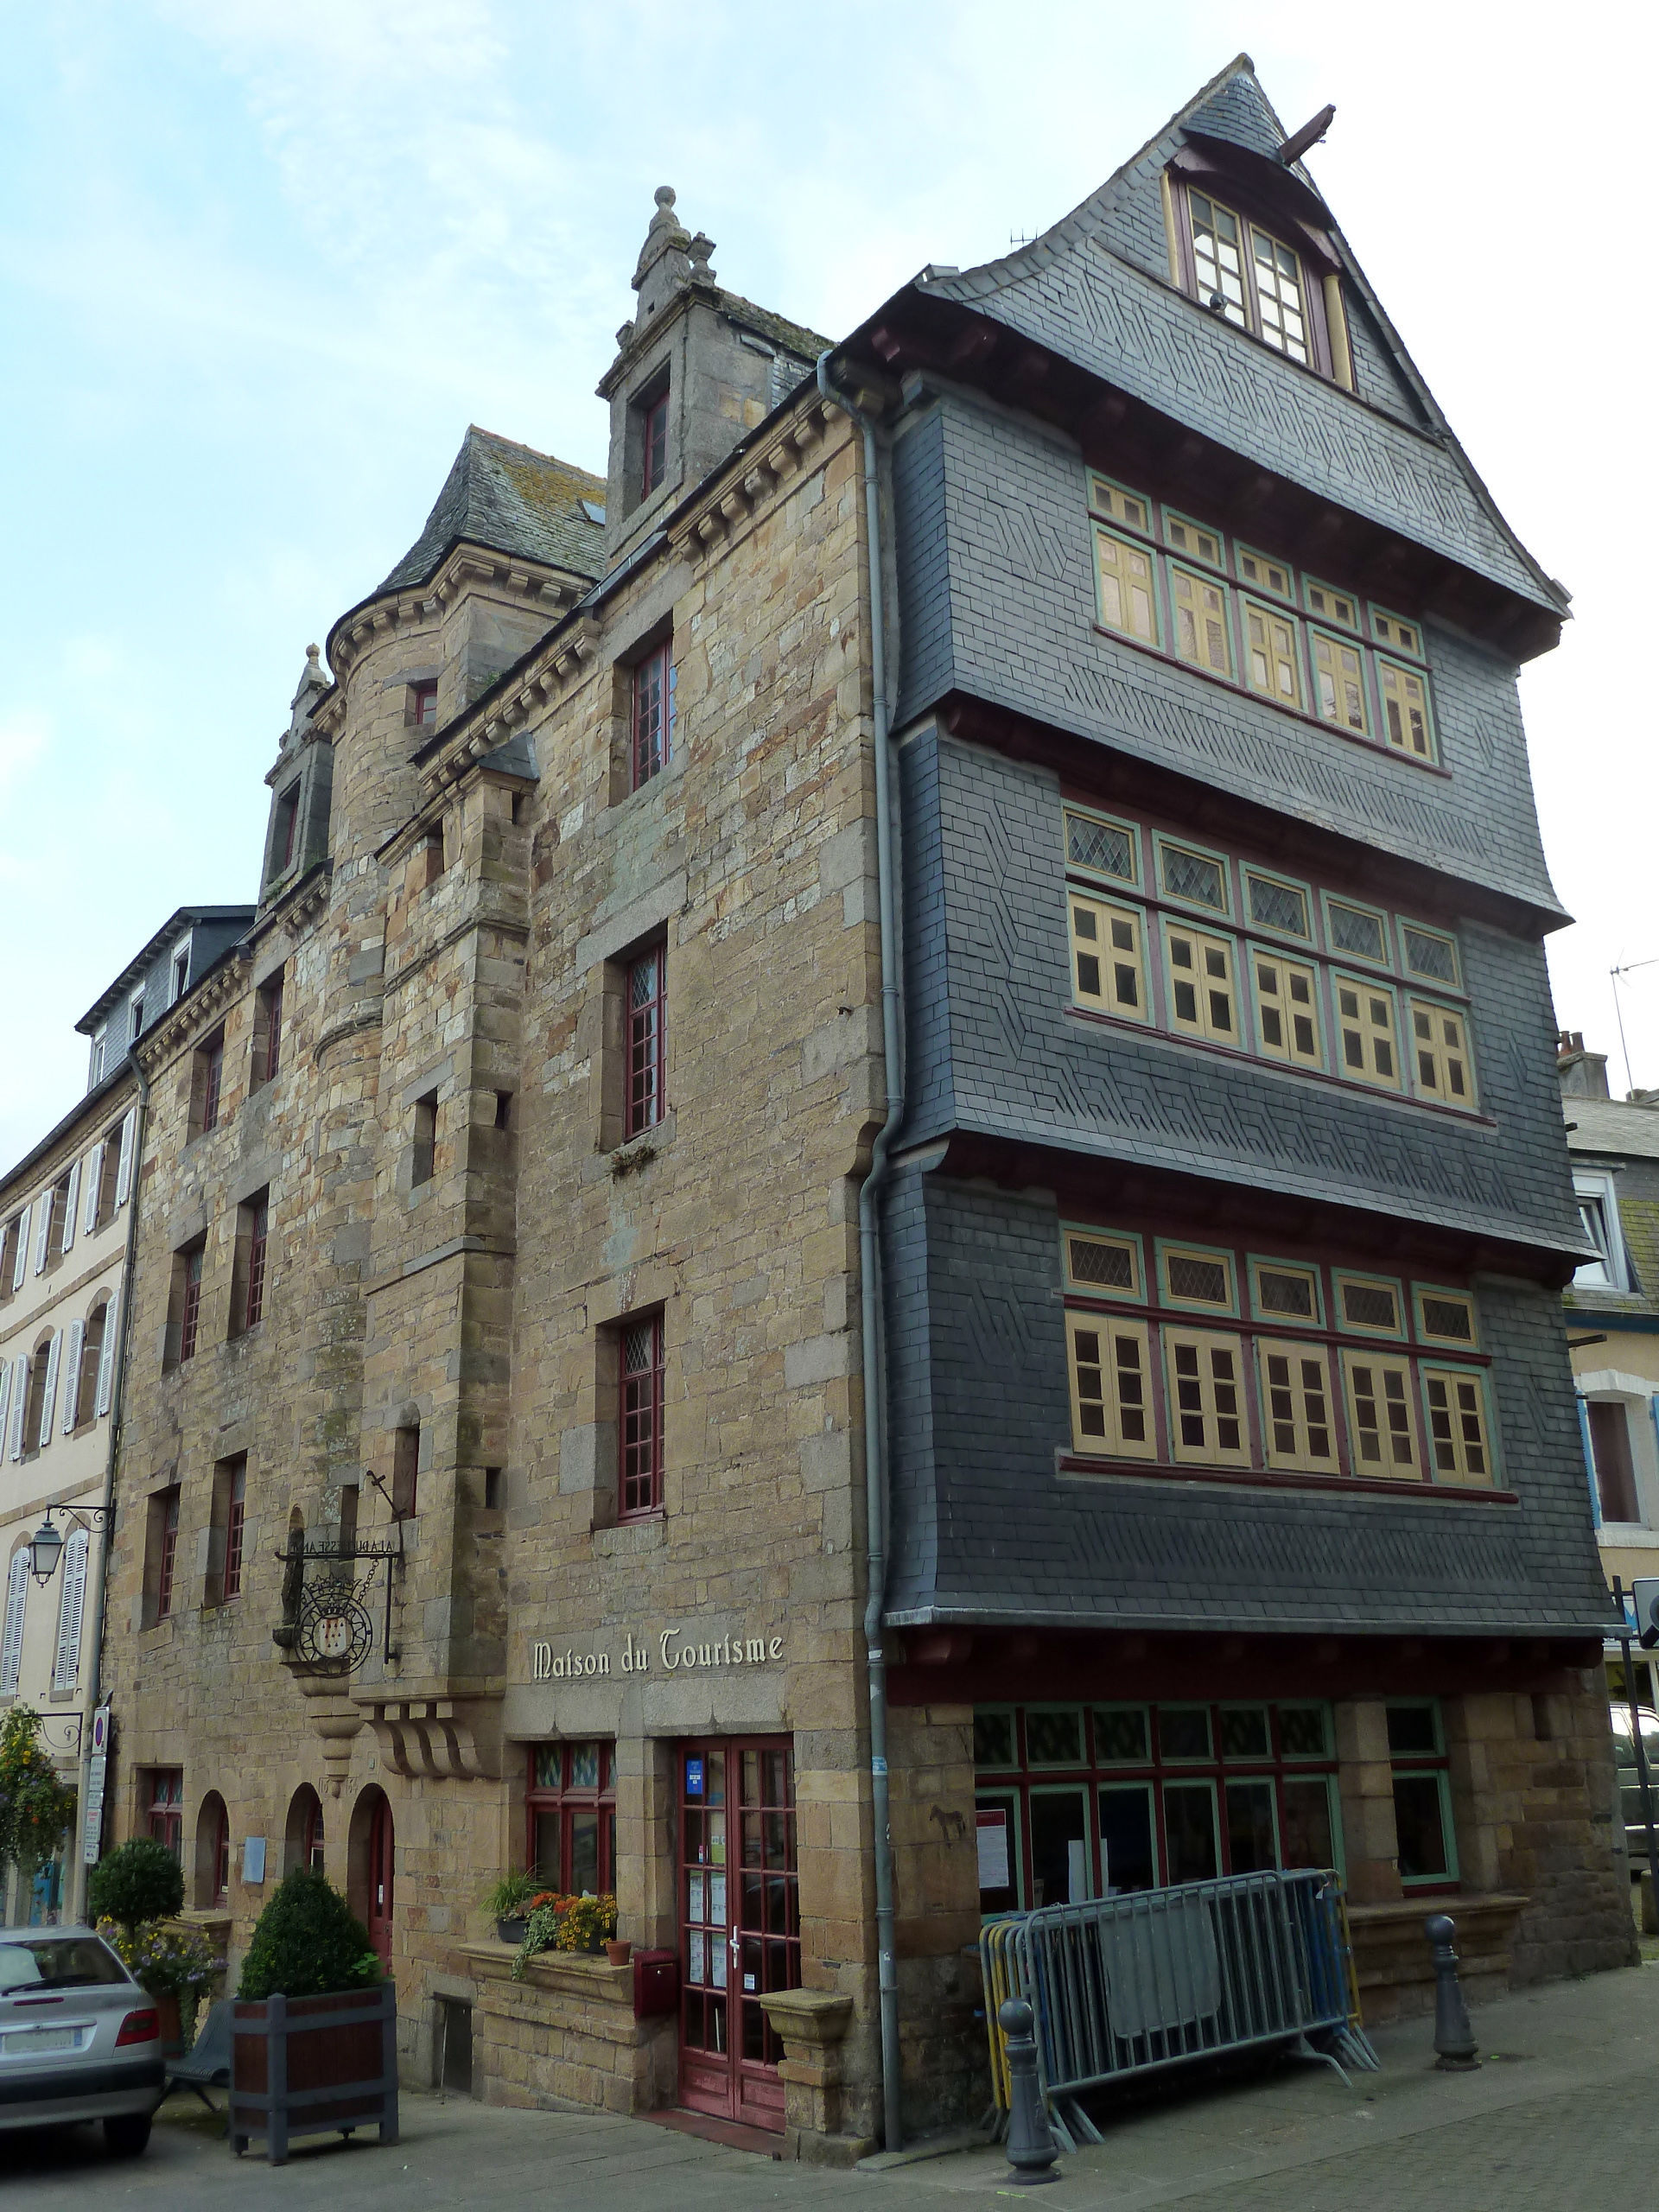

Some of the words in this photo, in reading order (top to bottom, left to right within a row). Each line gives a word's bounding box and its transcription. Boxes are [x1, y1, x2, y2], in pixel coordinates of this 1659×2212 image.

[533, 1642, 610, 1679] Maison
[620, 1632, 649, 1673] du
[659, 1628, 784, 1670] Tourisme
